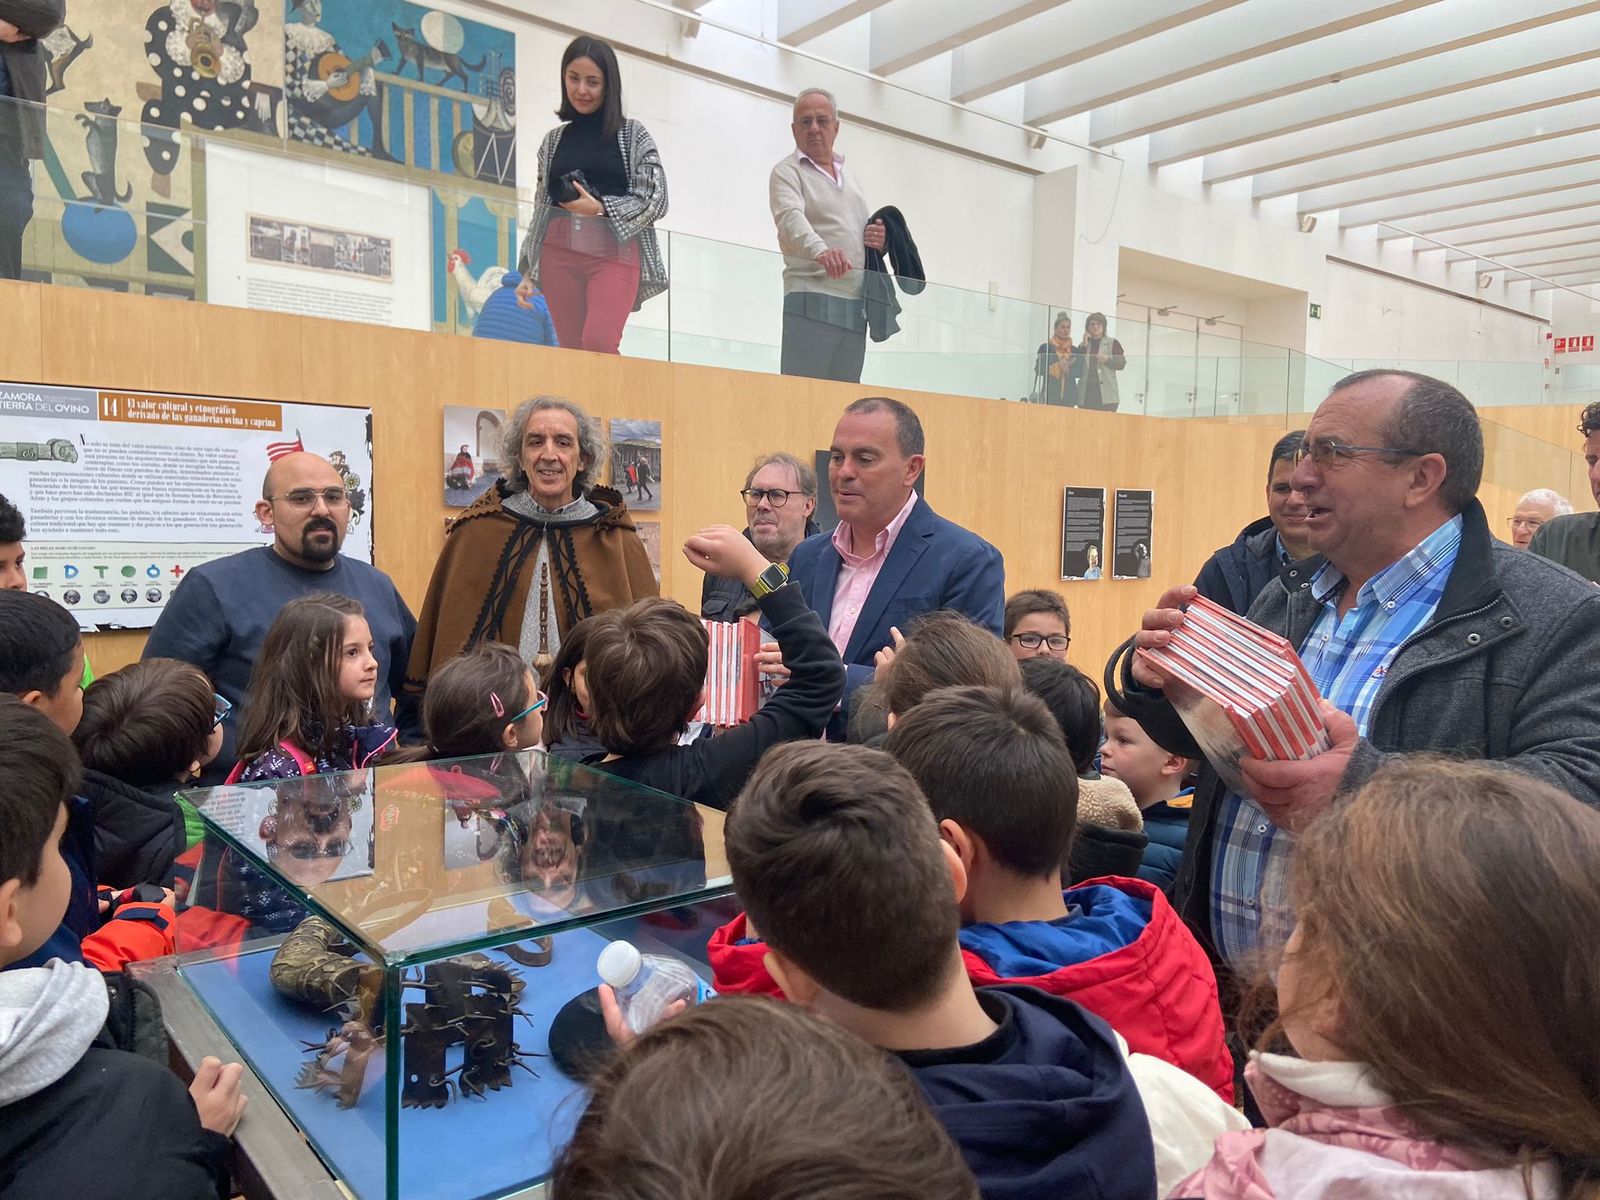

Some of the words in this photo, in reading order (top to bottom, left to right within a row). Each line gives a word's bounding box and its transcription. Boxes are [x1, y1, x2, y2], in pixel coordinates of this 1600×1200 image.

[35, 403, 53, 412] DEL
[55, 404, 90, 414] OVINO
[103, 398, 117, 416] 14
[128, 398, 135, 408] El
[137, 399, 156, 410] valor
[158, 401, 188, 412] cultural
[128, 408, 160, 419] derivado
[162, 411, 170, 420] de
[172, 411, 183, 421] las
[225, 415, 243, 425] ovina
[250, 417, 276, 428] caprina
